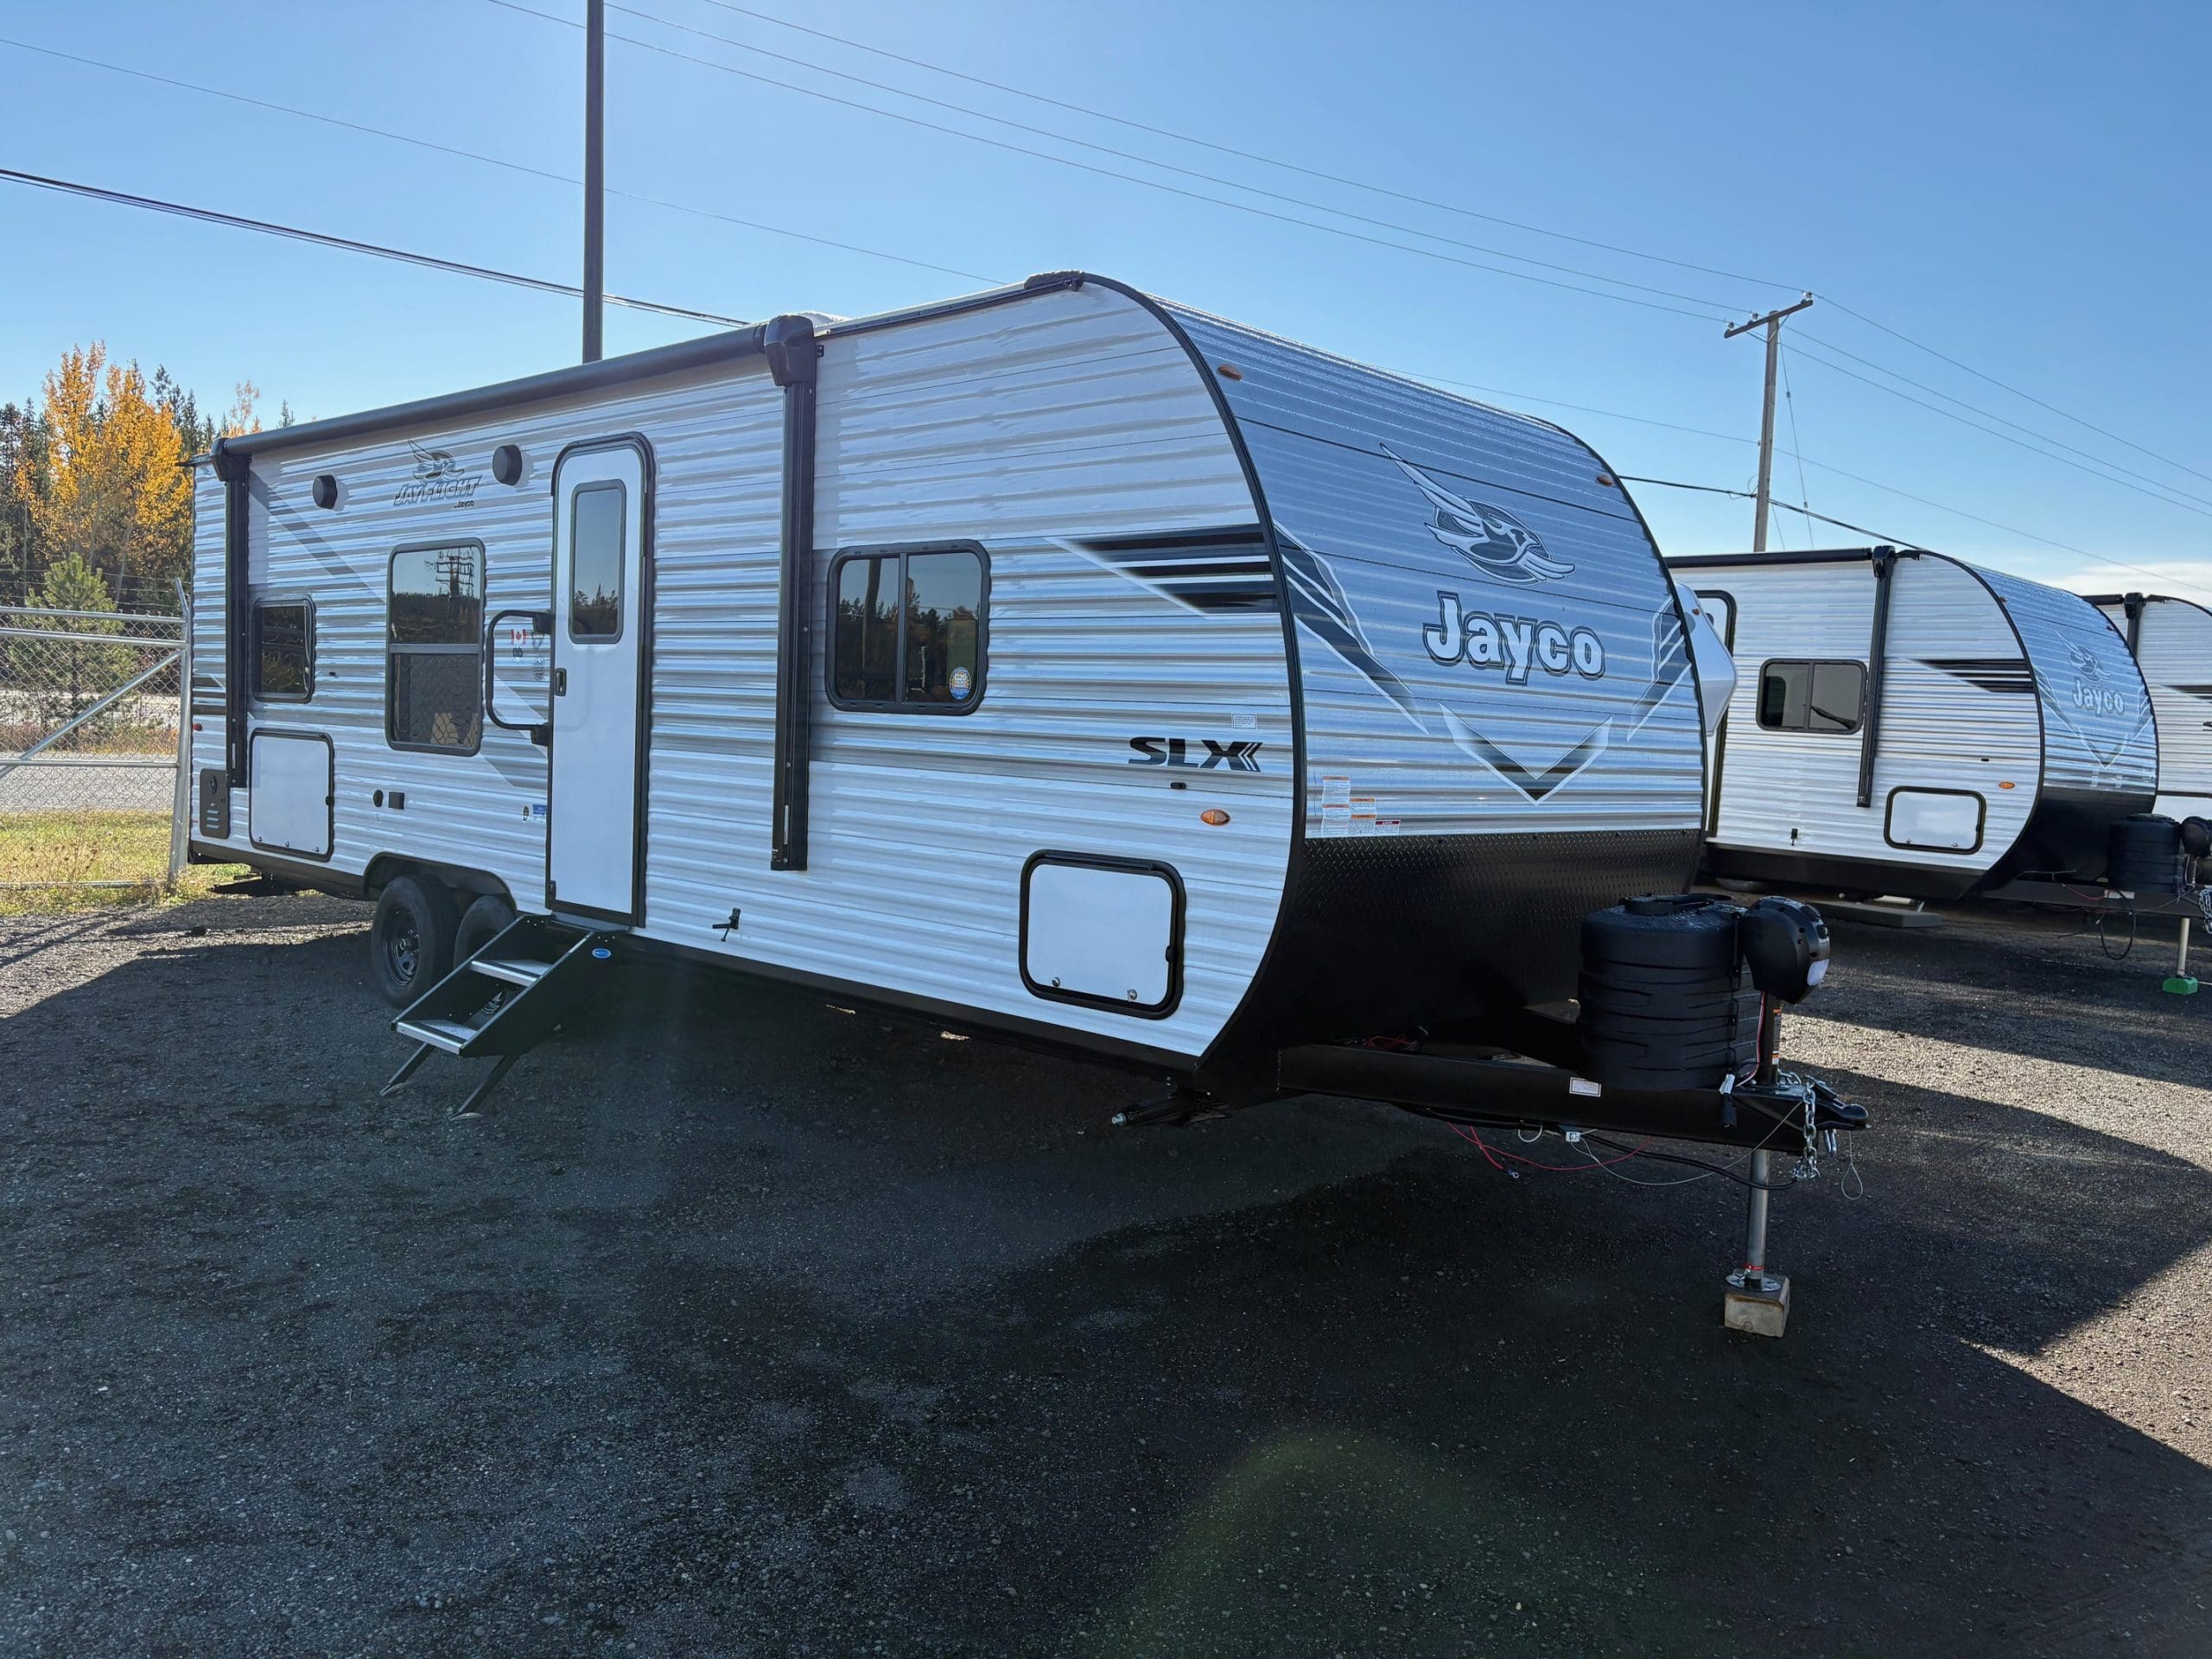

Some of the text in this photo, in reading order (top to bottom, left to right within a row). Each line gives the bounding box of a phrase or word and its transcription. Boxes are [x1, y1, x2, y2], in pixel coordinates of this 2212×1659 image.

[1423, 589, 1605, 686] Jayco
[2072, 677, 2125, 716] Jayco
[1128, 736, 1263, 772] SLX
